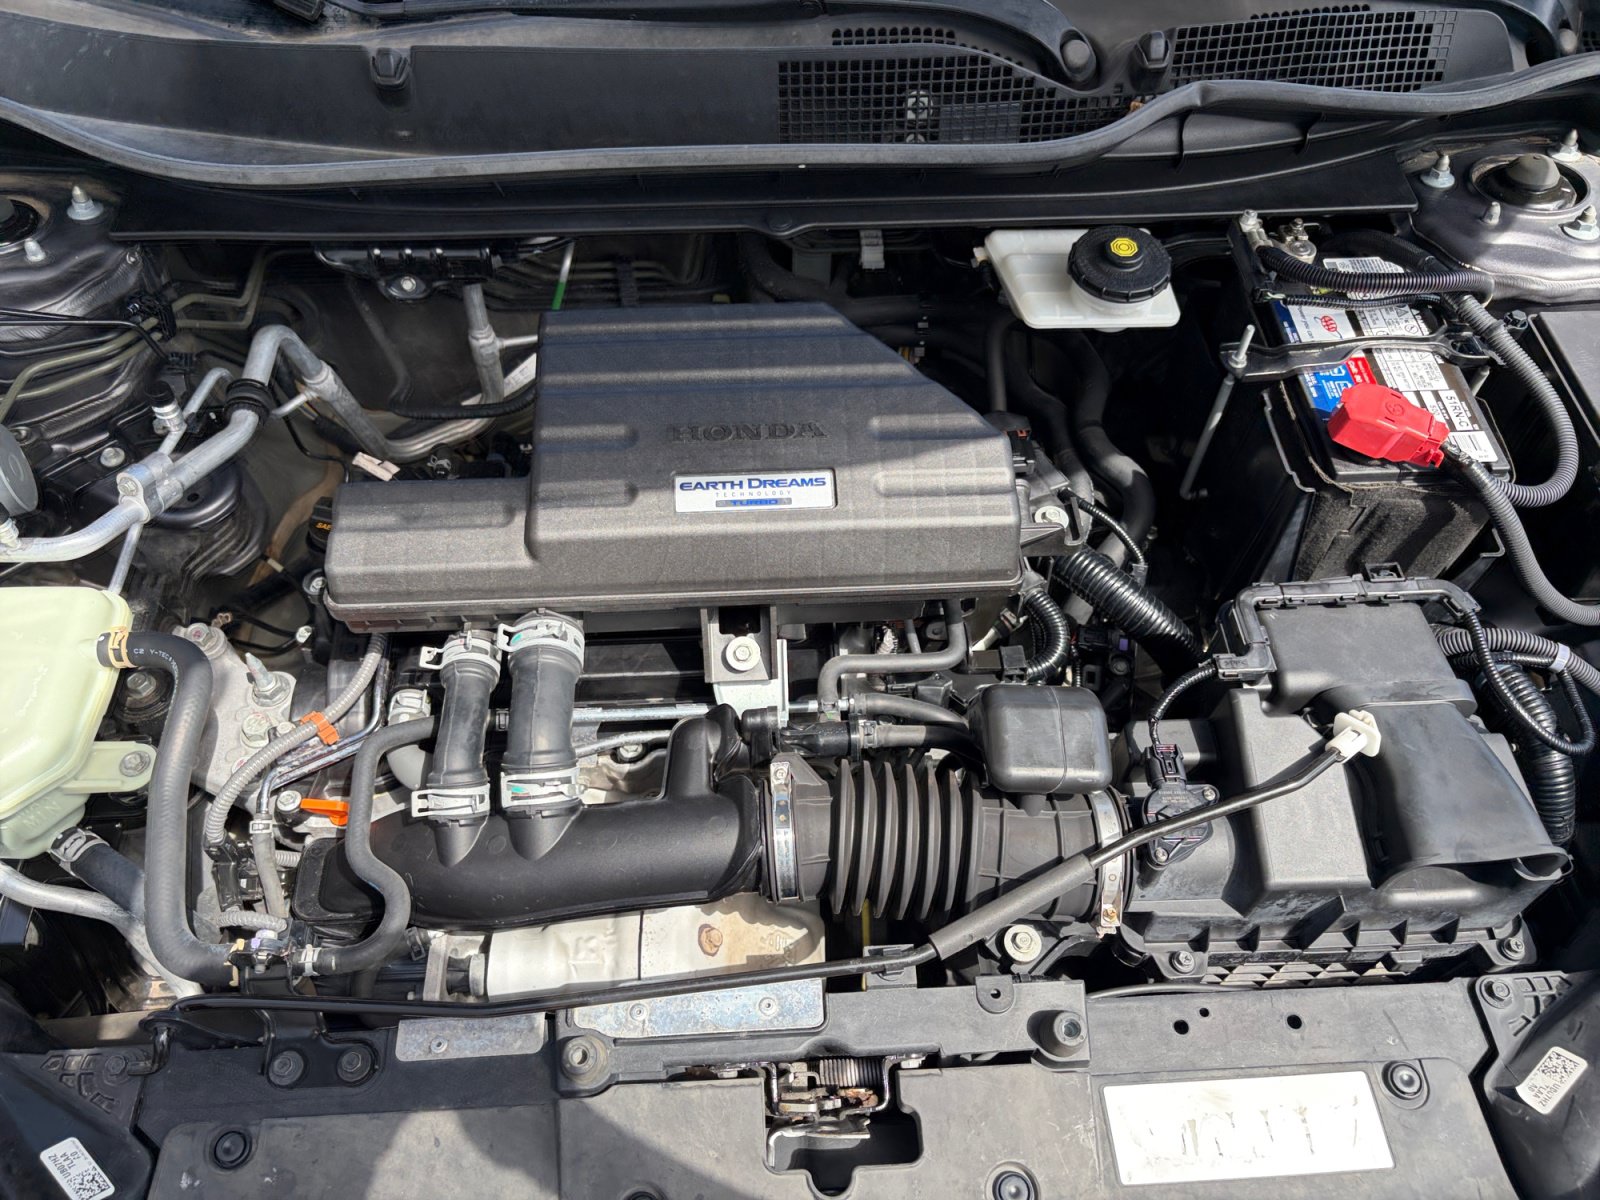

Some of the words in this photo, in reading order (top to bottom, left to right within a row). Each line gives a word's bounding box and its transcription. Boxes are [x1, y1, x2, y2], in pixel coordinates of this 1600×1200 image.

[1446, 395, 1469, 428] 51RN-C
[670, 422, 829, 442] HONDA
[679, 479, 744, 491] EARTH
[747, 477, 827, 490] DREAMS
[715, 490, 792, 498] TECHNOLOGY
[730, 498, 779, 506] TURBO
[48, 1153, 71, 1179] UB07HZ
[60, 1152, 76, 1170] TLAA
